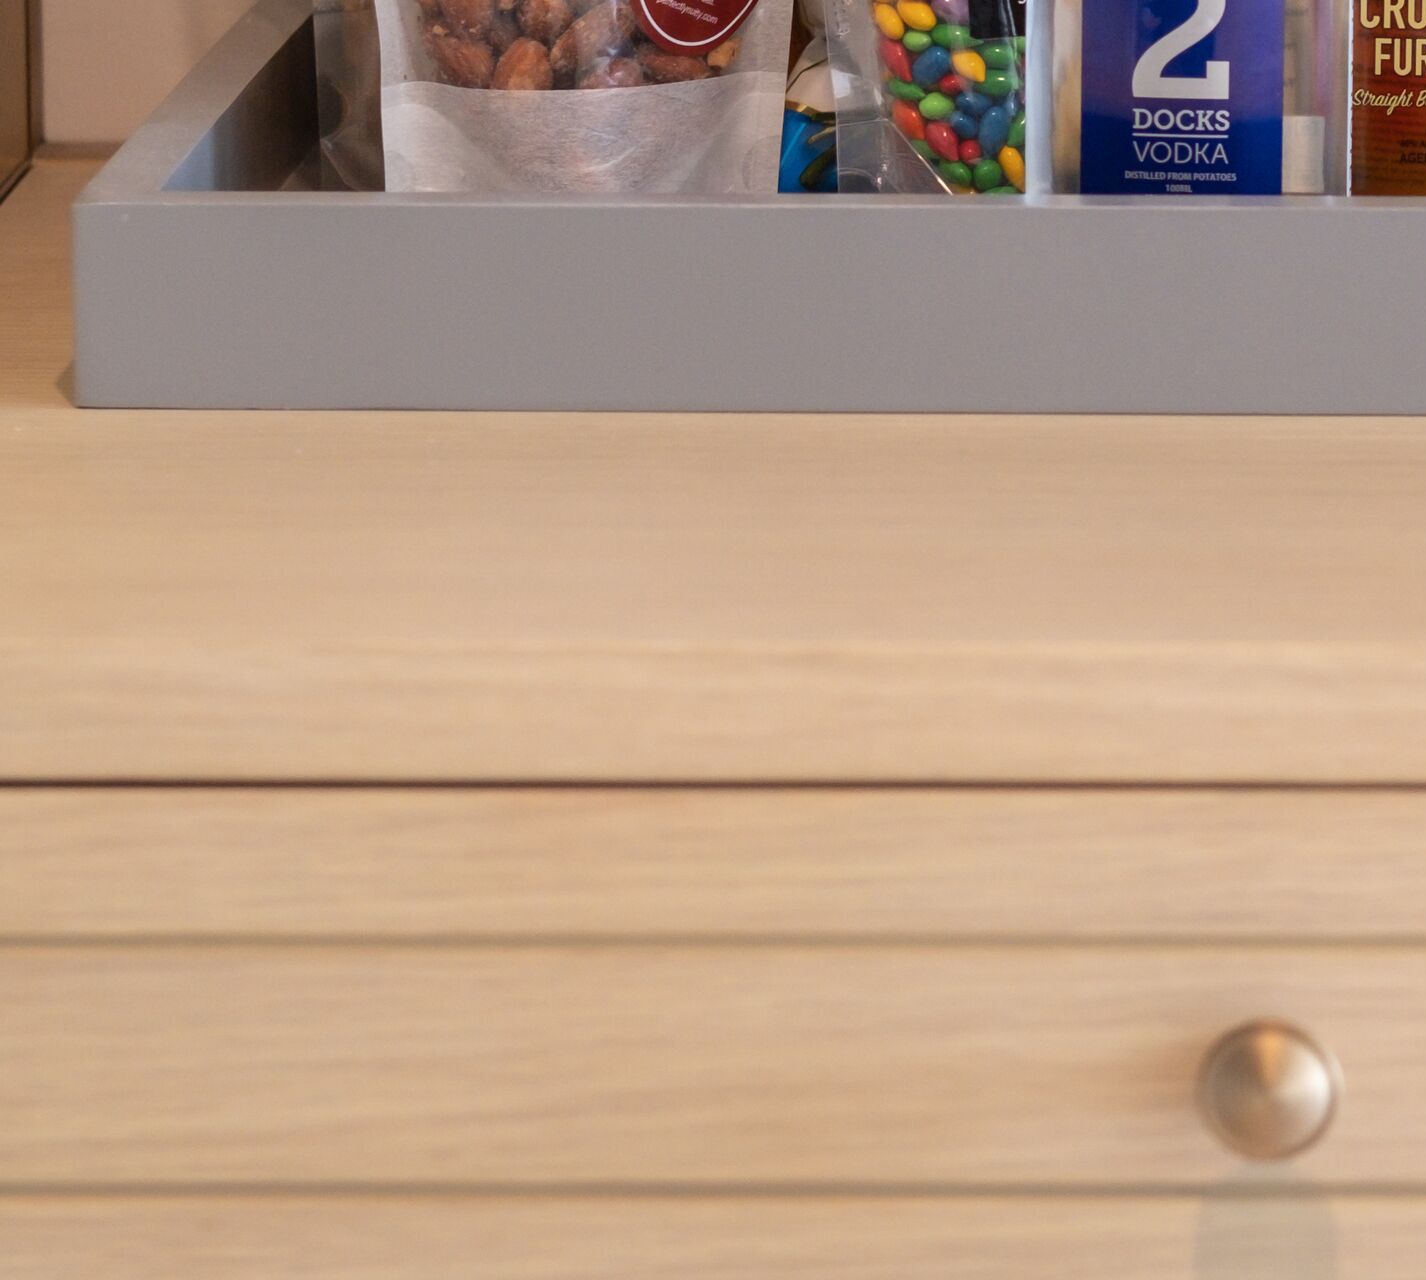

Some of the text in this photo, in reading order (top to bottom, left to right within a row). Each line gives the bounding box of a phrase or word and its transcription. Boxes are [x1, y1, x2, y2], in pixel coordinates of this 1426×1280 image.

[1351, 88, 1414, 116] Straight
[1131, 107, 1231, 132] DOCKS
[1132, 140, 1229, 165] VODKA
[1124, 169, 1238, 182] DISTILLED FROM POTATOES
